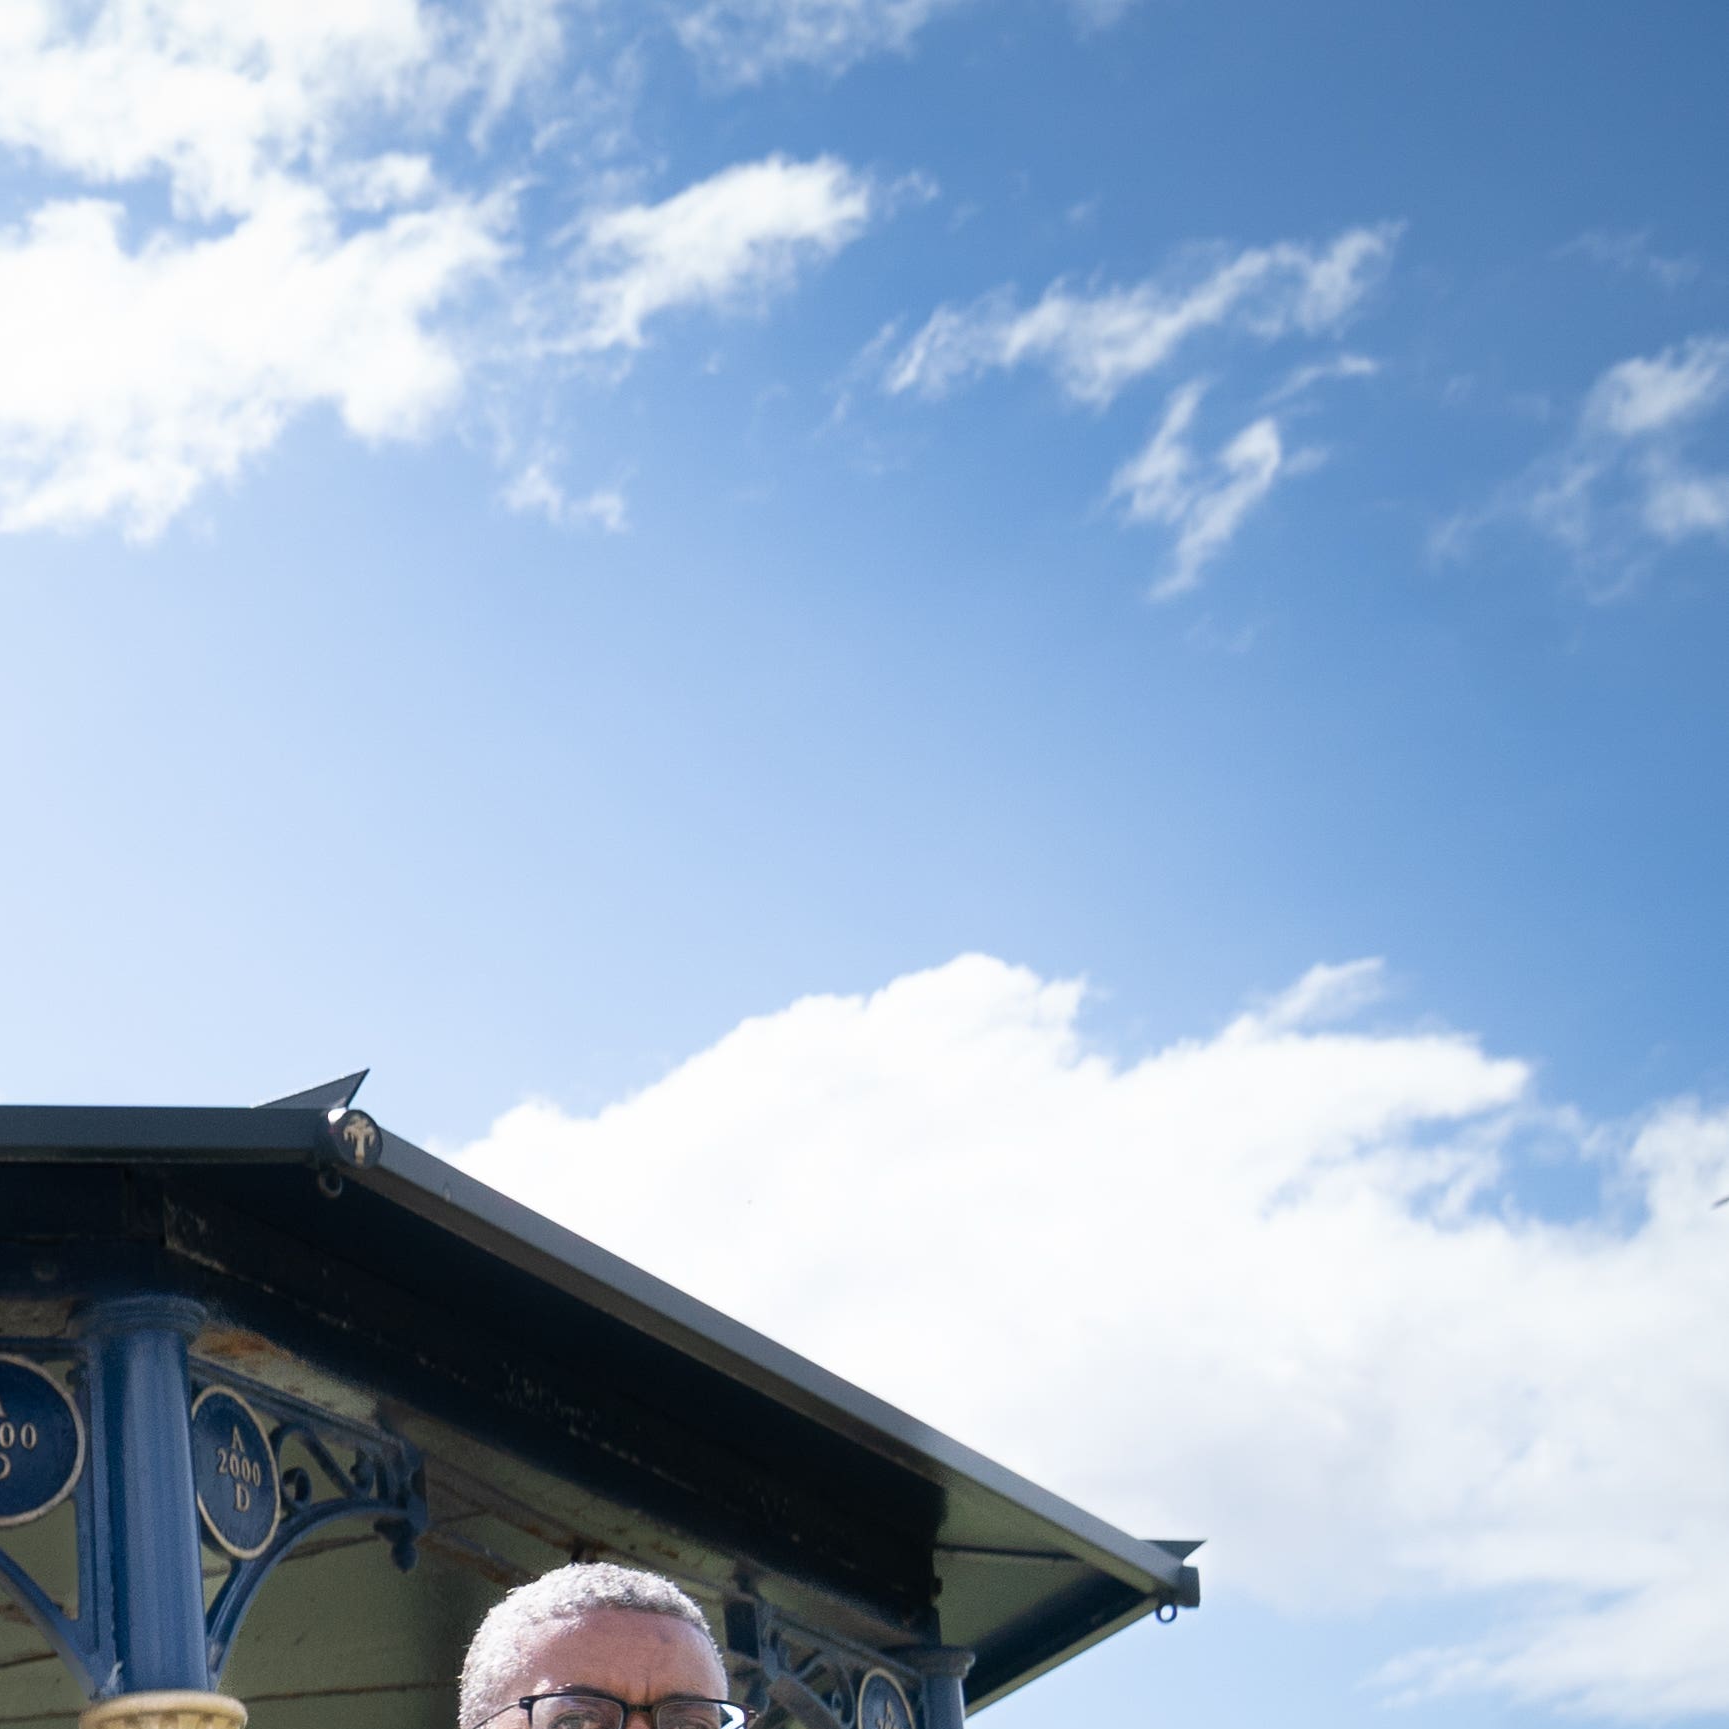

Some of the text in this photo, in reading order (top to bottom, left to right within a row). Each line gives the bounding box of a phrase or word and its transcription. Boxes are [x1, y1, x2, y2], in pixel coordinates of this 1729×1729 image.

[230, 1424, 245, 1452] A
[216, 1448, 262, 1487] 2000
[235, 1483, 251, 1512] D
